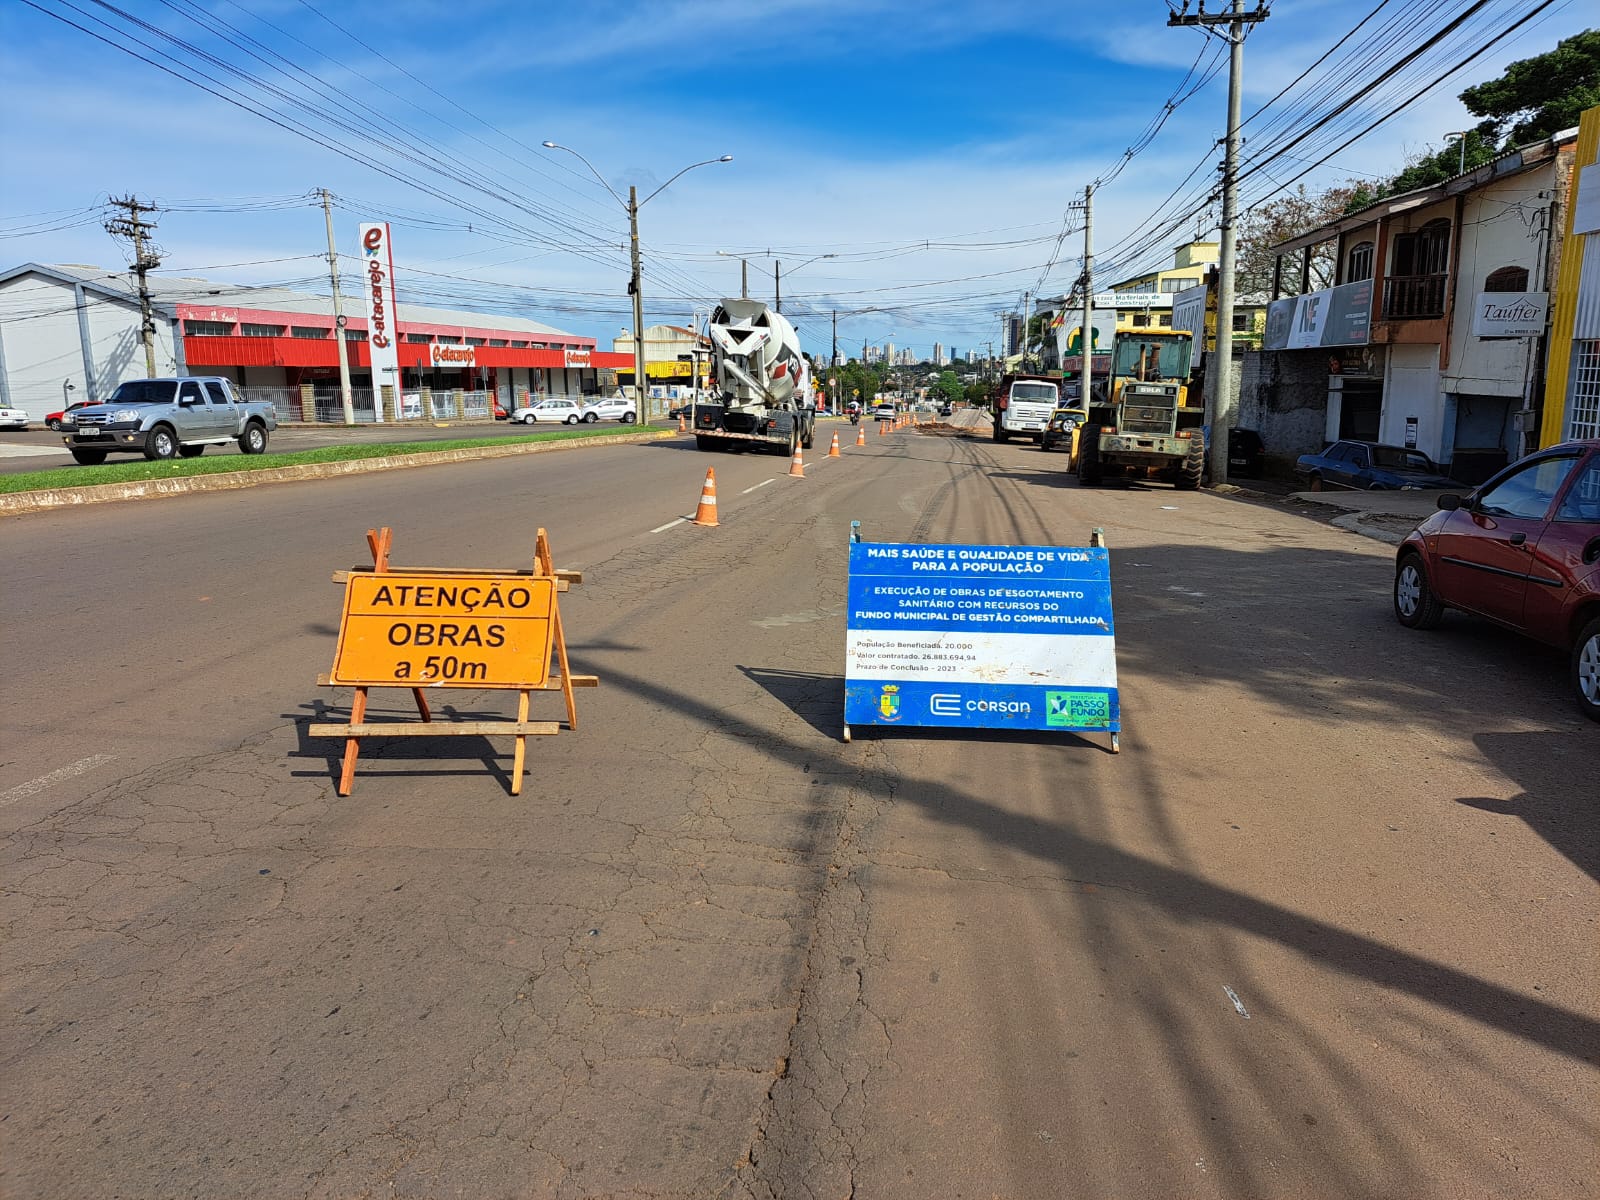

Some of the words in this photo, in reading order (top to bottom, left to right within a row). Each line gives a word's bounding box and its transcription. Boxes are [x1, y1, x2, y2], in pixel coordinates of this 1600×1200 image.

[368, 260, 388, 349] e-atacarejo
[1483, 303, 1541, 321] Tauffer
[868, 549, 899, 558] MAIS
[902, 547, 944, 559] SAÚDE
[948, 550, 955, 559] E
[959, 550, 1034, 561] QUALIDADE
[1037, 552, 1054, 560] DE
[1058, 552, 1089, 562] VIDA
[912, 561, 946, 571] PARA
[950, 562, 959, 571] A
[962, 561, 1043, 574] POPULAÇÃO
[371, 583, 531, 613] ATENÇÃO
[874, 585, 930, 596] EXECUÇÃO
[933, 587, 947, 596] DE
[950, 588, 985, 597] OBRAS
[988, 589, 1002, 597] DE
[1005, 589, 1084, 599] ESGOTAMENTO
[898, 599, 955, 608] SANITÁRIO
[958, 600, 981, 609] COM
[984, 601, 1040, 610] RECURSOS
[1043, 602, 1059, 611] DO
[855, 611, 891, 619] FUNDO
[894, 611, 949, 620] MUNICIPAL
[952, 613, 966, 621] DE
[968, 613, 1011, 622] GESTÃO
[1014, 614, 1105, 624] COMPARTILHADA
[388, 622, 506, 648] OBRAS
[857, 641, 895, 649] População
[394, 660, 411, 679] a
[423, 656, 487, 680] 50m
[1071, 700, 1105, 709] PASSO
[1071, 708, 1105, 716] FUNDO
